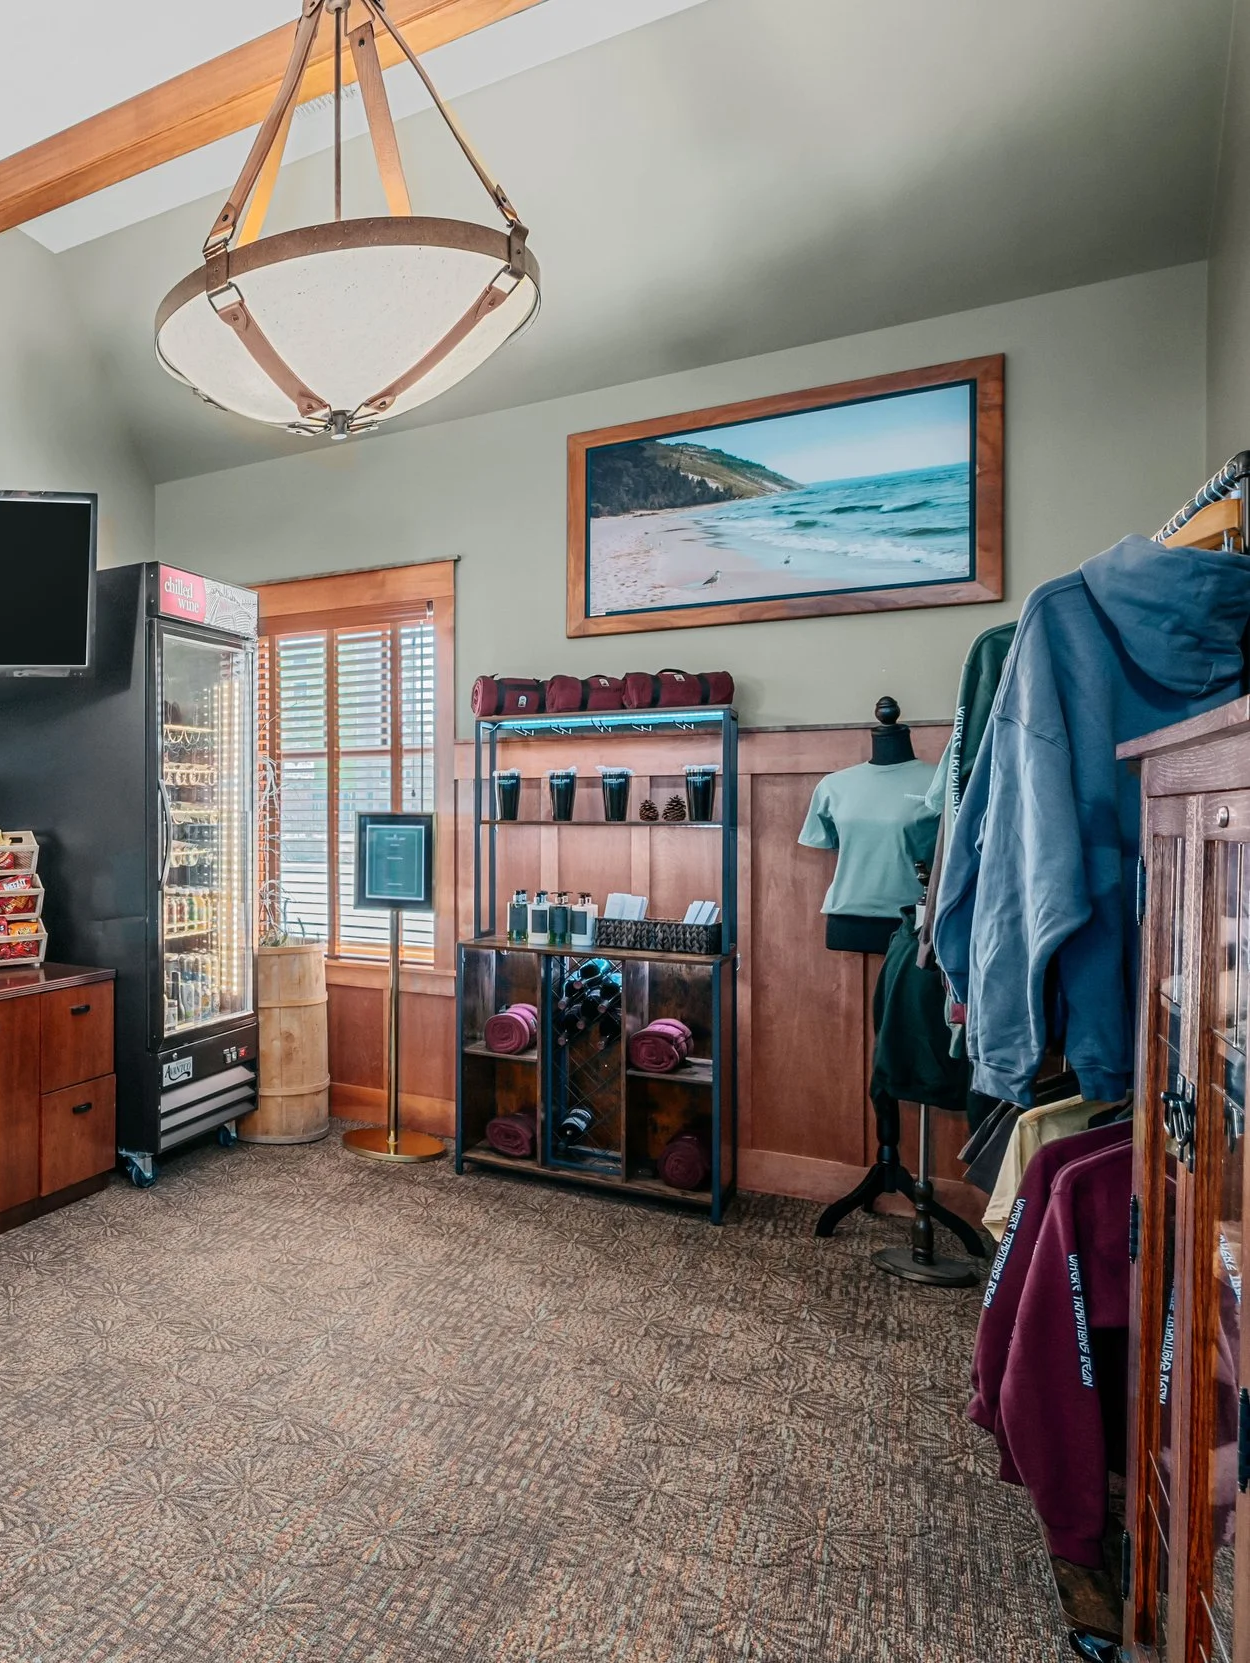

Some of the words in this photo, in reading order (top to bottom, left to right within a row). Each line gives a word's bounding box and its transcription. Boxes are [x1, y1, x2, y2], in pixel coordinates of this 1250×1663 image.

[164, 576, 193, 599] chilled
[178, 597, 200, 613] wine
[1008, 1198, 1026, 1231] WHERE
[992, 1232, 1014, 1281] TRADITIONS
[1067, 1253, 1082, 1293] WHERE
[983, 1281, 998, 1309] BEGIN
[1072, 1295, 1090, 1355] TRADITIONS
[1081, 1355, 1094, 1388] BEGIN
